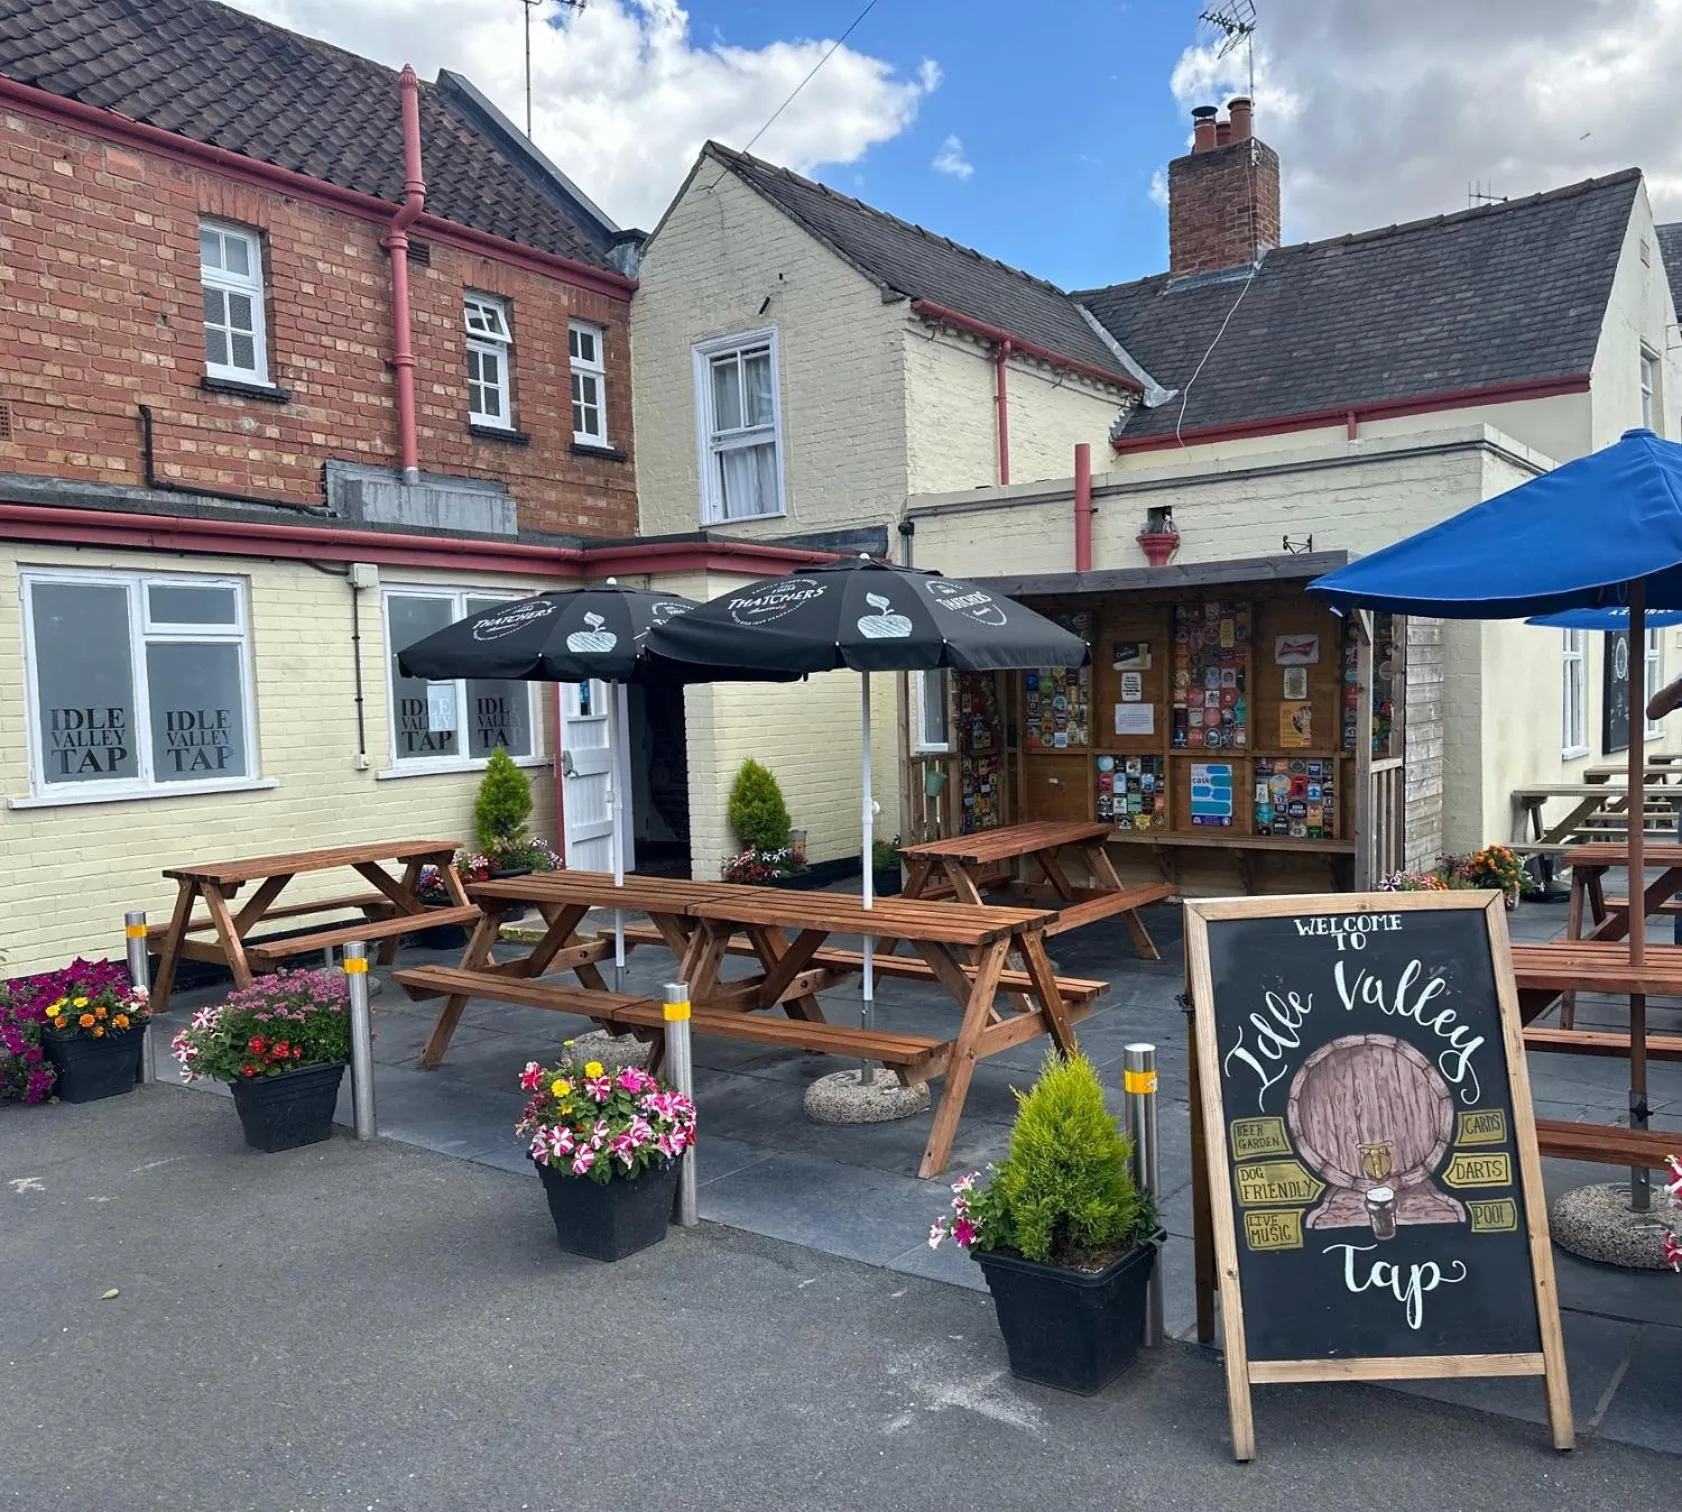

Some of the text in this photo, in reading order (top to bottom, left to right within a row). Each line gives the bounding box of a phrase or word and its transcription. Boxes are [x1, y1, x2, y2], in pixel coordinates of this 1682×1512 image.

[727, 585, 828, 610] THATCHERS
[472, 606, 557, 630] THATCHERS
[50, 708, 126, 731] IDLE
[165, 709, 232, 731] IDLE
[50, 729, 126, 748] VALLEY
[166, 729, 232, 747] VALLEY
[401, 730, 453, 752] TAP
[51, 746, 128, 775] TAP
[166, 746, 235, 772] TAP
[1293, 914, 1403, 936] WELCOME
[1331, 932, 1367, 951] TO
[1224, 959, 1485, 1113] Idle Valley
[1235, 1123, 1264, 1137] BEER
[1465, 1114, 1501, 1135] CARDS
[1238, 1138, 1280, 1150] GARDEN
[1240, 1167, 1265, 1182] DOG
[1456, 1160, 1503, 1180] DARTS
[1242, 1179, 1313, 1200] FRIENDLY
[1248, 1214, 1279, 1227] LIVE
[1250, 1224, 1292, 1245] MUSIC
[1321, 1243, 1467, 1330] Tap
